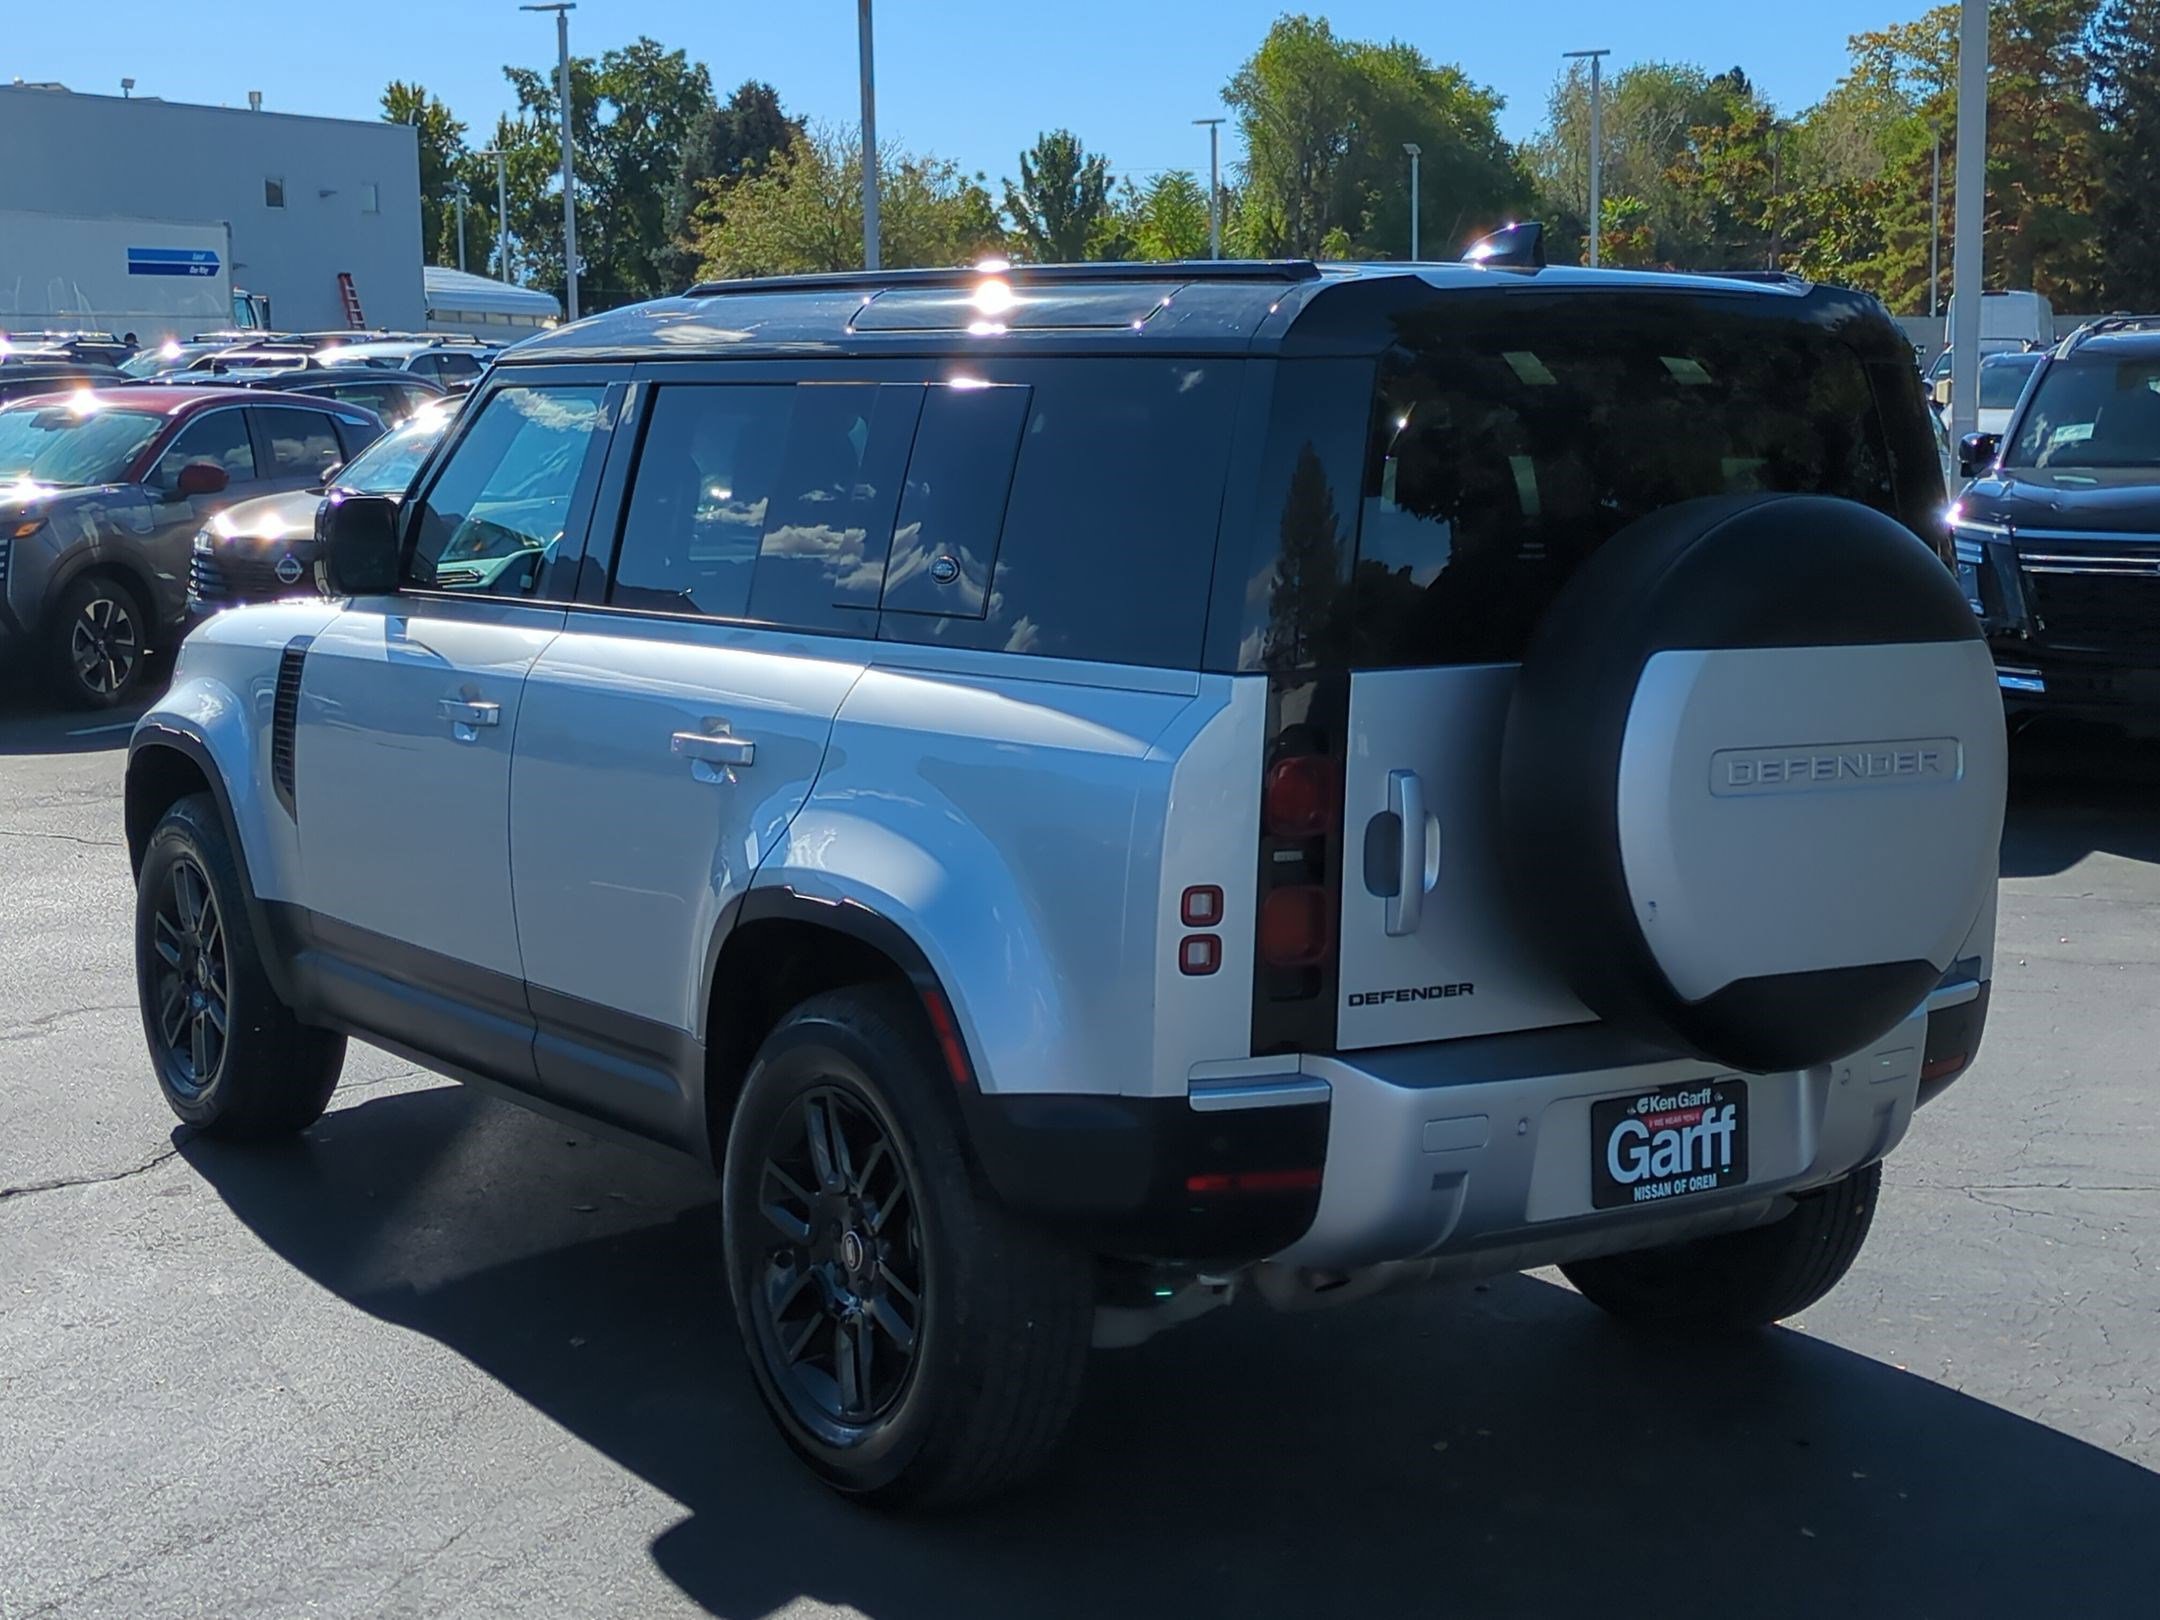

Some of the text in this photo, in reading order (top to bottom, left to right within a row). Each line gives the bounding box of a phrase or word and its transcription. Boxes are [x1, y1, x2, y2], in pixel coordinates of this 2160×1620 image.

[1728, 751, 1941, 786] DEFENDER
[1348, 982, 1474, 1007] DEFENDER
[1649, 1096, 1677, 1113] Ken
[1678, 1088, 1712, 1107] Garff
[1607, 1104, 1736, 1184] Garff
[1634, 1173, 1717, 1201] NISSAN OF OREM
